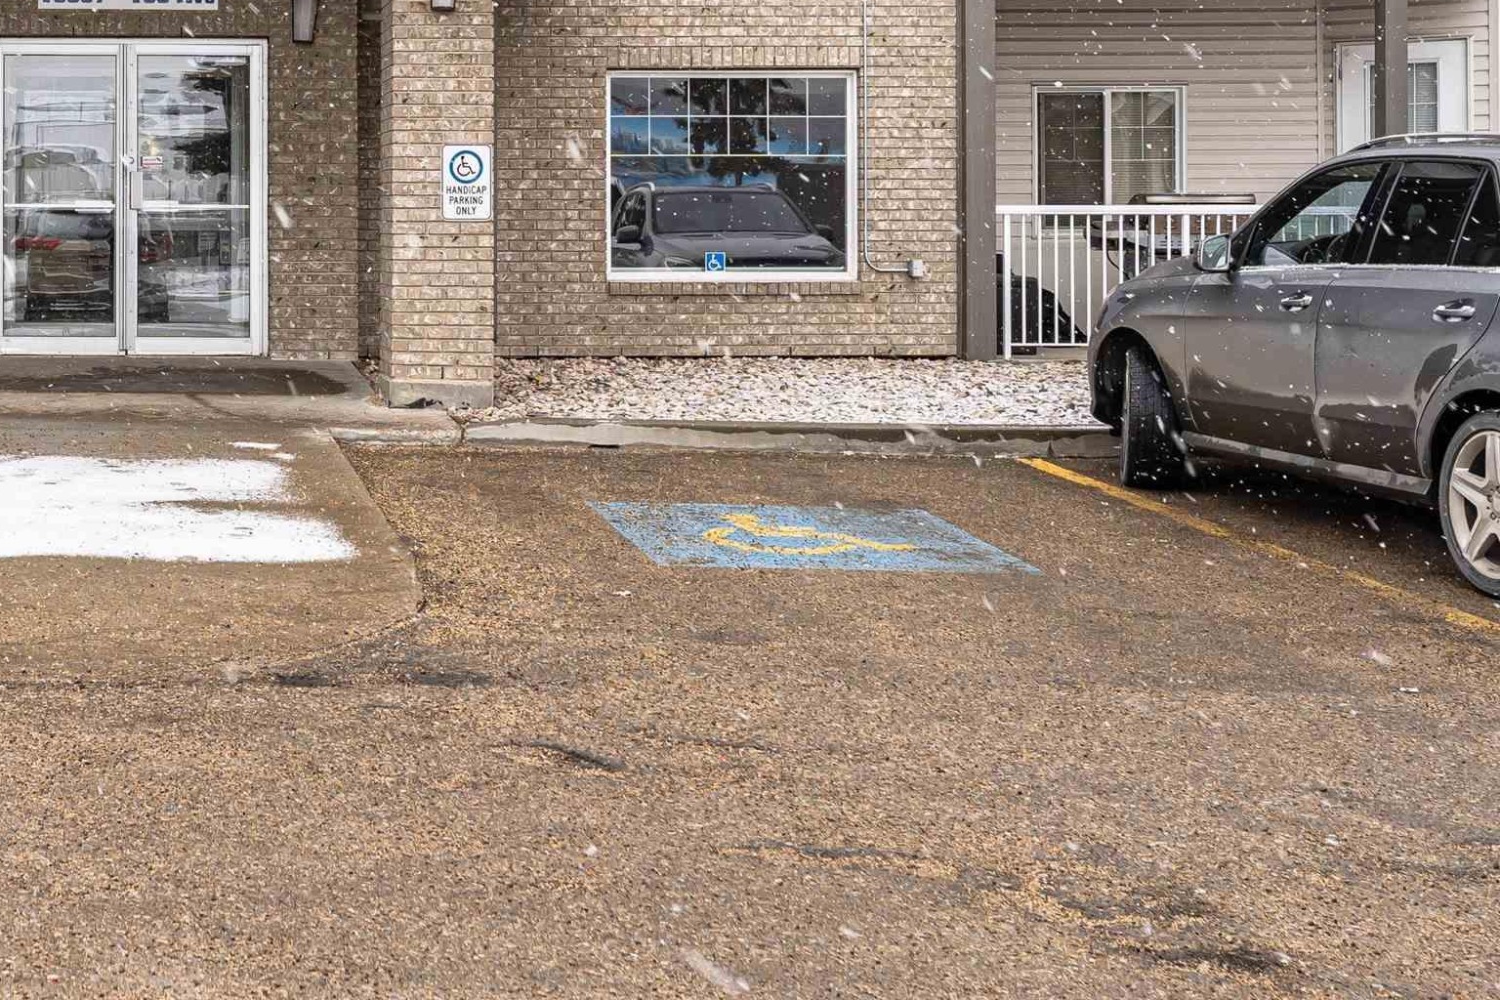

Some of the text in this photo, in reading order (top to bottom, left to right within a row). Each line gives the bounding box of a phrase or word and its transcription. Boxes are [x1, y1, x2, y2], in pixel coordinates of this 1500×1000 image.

[445, 185, 487, 195] HANDICAP
[449, 195, 484, 205] PARKING
[455, 206, 477, 215] ONLY
